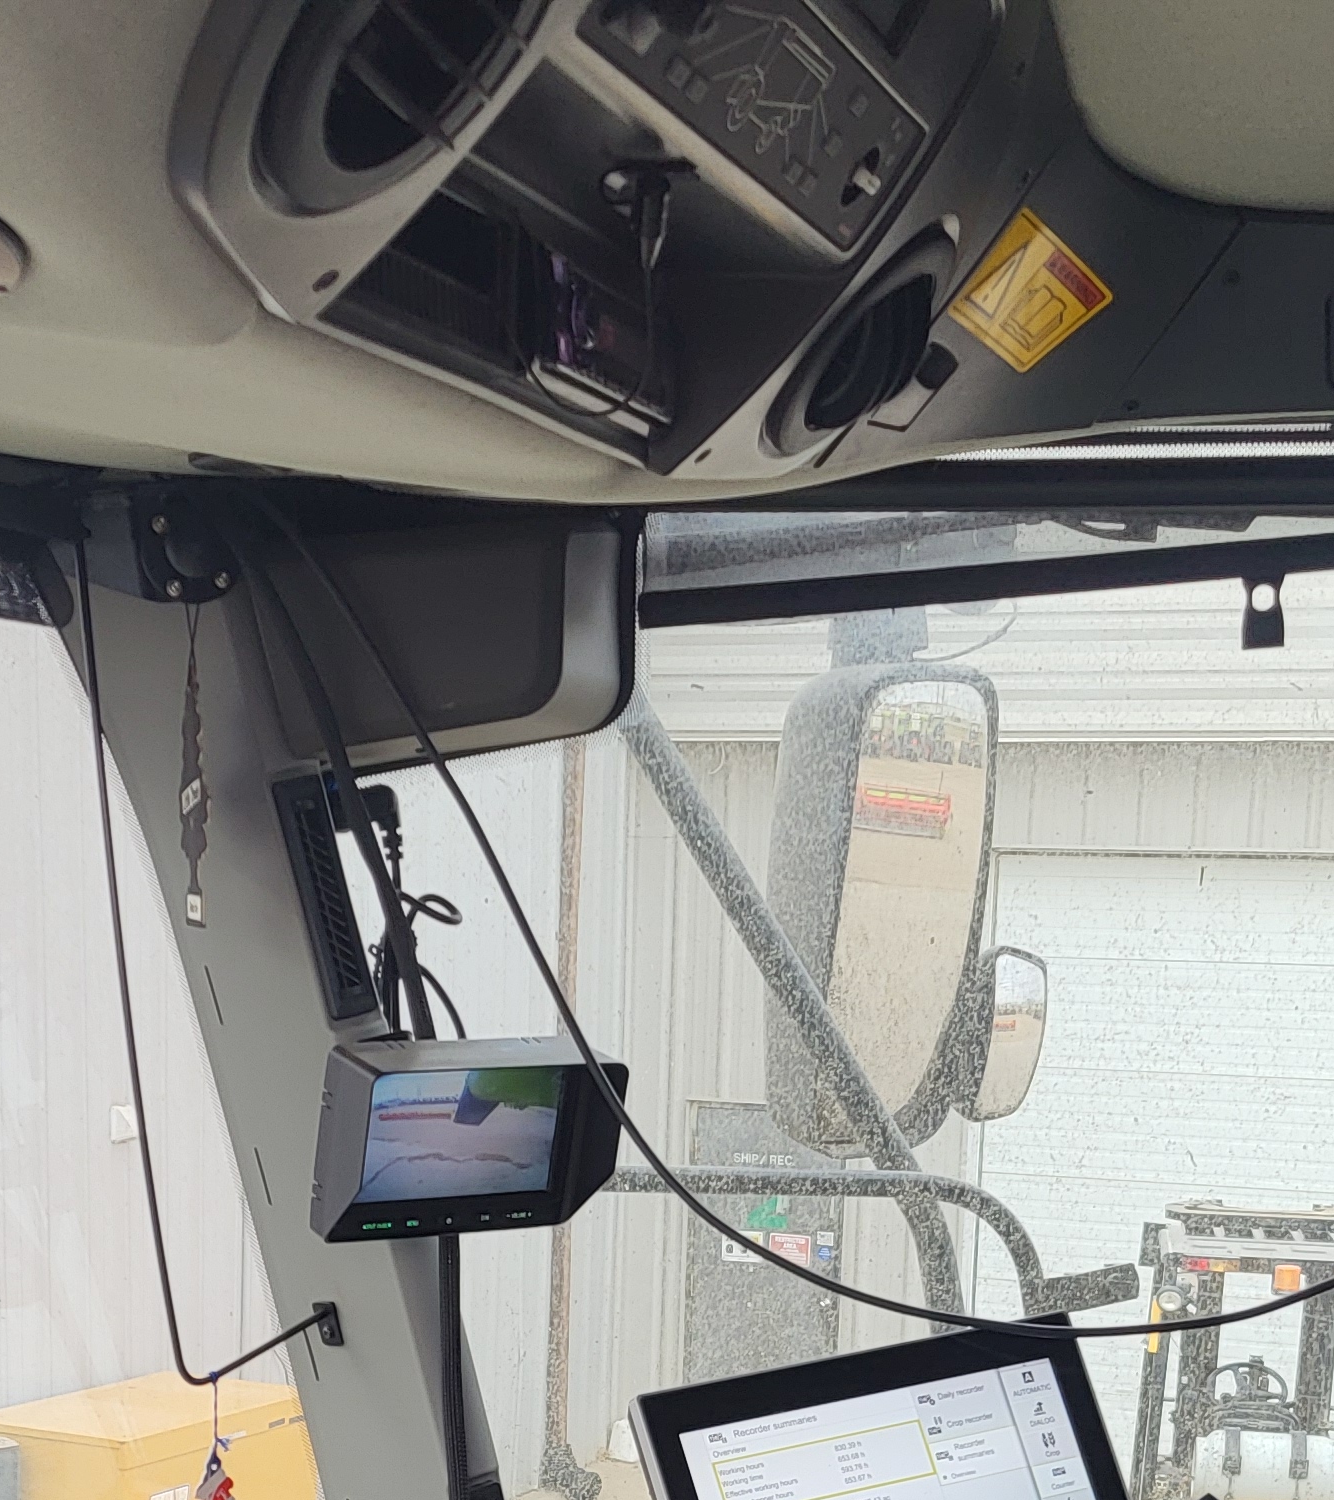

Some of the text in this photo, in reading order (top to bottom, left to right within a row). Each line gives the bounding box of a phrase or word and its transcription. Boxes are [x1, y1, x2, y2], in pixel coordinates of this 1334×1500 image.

[937, 1385, 985, 1401] Daily recorder
[1013, 1383, 1052, 1397] AUTOMATIC
[733, 1415, 818, 1438] Recorder summaries
[946, 1413, 993, 1429] Crop recorder
[1029, 1416, 1056, 1428] DIALOG
[953, 1439, 985, 1451] Recorder
[712, 1447, 747, 1459] Overview
[957, 1449, 995, 1462] summaries
[1045, 1450, 1061, 1458] Crop
[718, 1462, 765, 1477] Working hours
[951, 1470, 977, 1480] Overview
[721, 1474, 764, 1488] Working time
[1051, 1480, 1075, 1491] Counter
[725, 1479, 799, 1499] Effective working hours
[775, 1491, 795, 1499] hours
